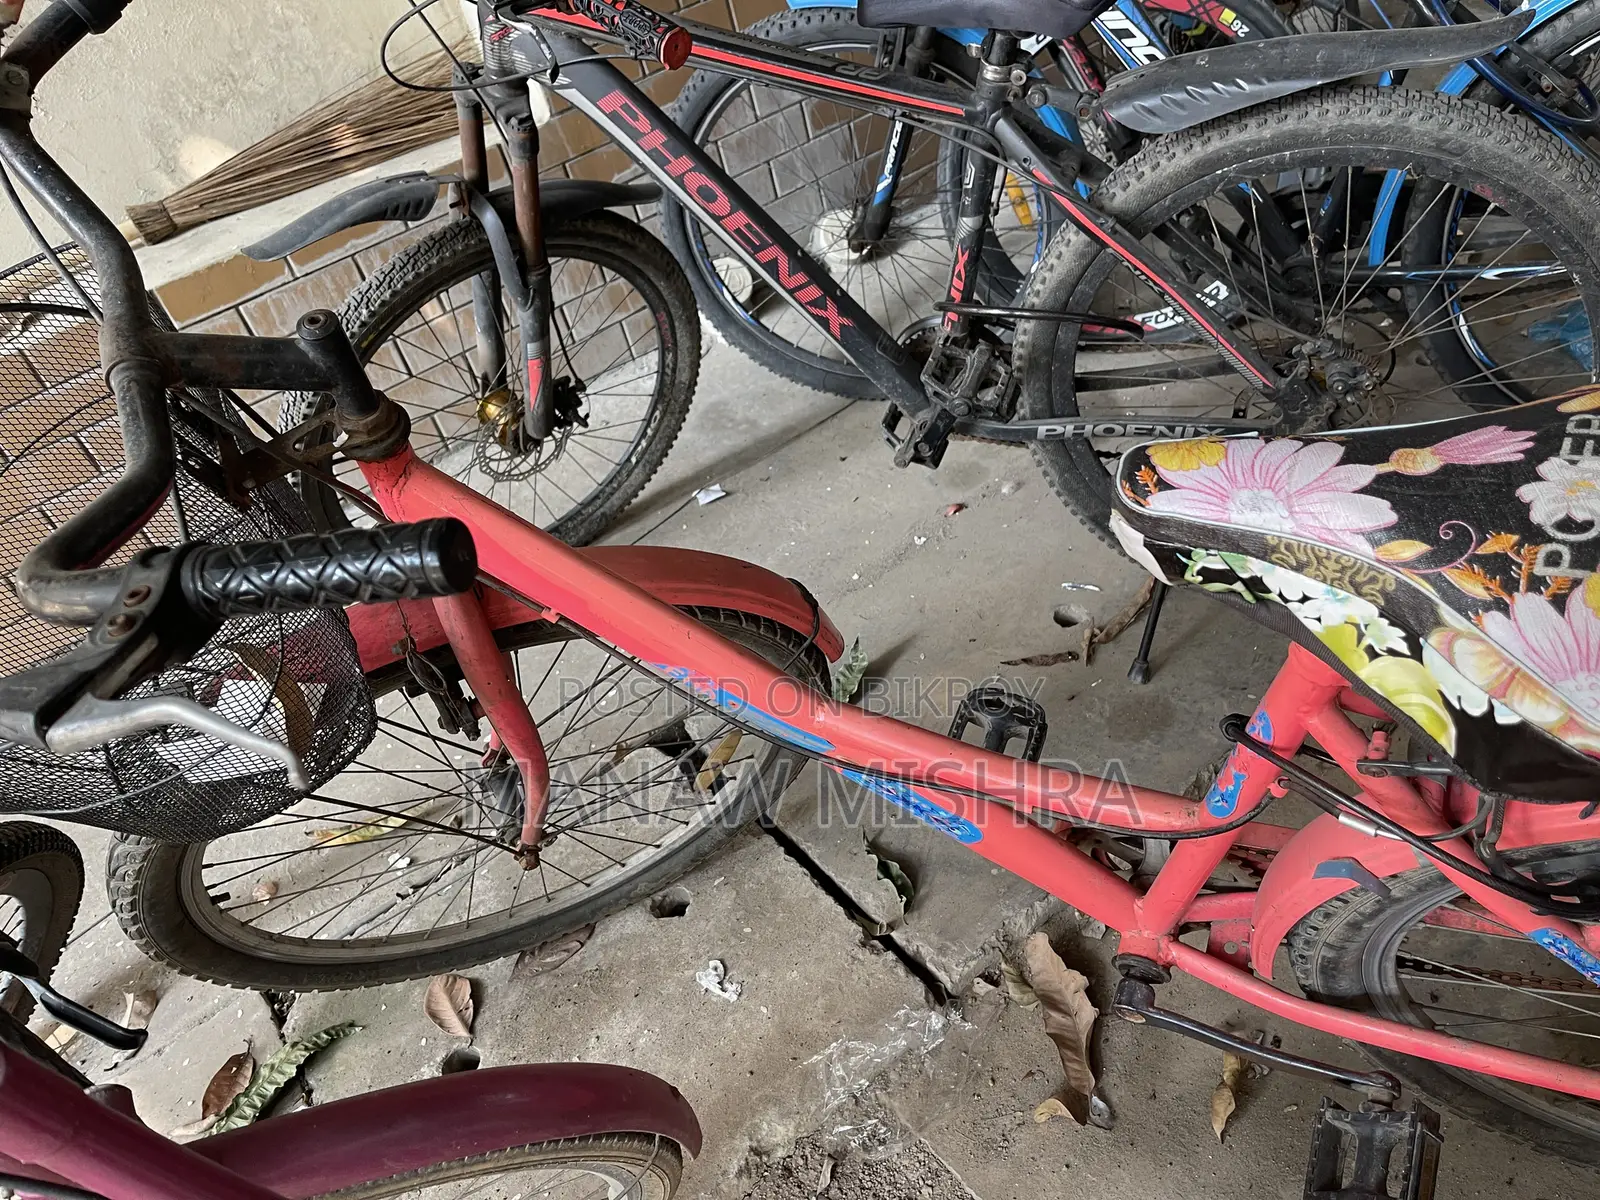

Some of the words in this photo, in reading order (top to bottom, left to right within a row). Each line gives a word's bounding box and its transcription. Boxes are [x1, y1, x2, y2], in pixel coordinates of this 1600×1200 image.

[1230, 19, 1250, 38] 26
[597, 89, 854, 341] PHOENIX
[1036, 423, 1225, 441] PHOENIX
